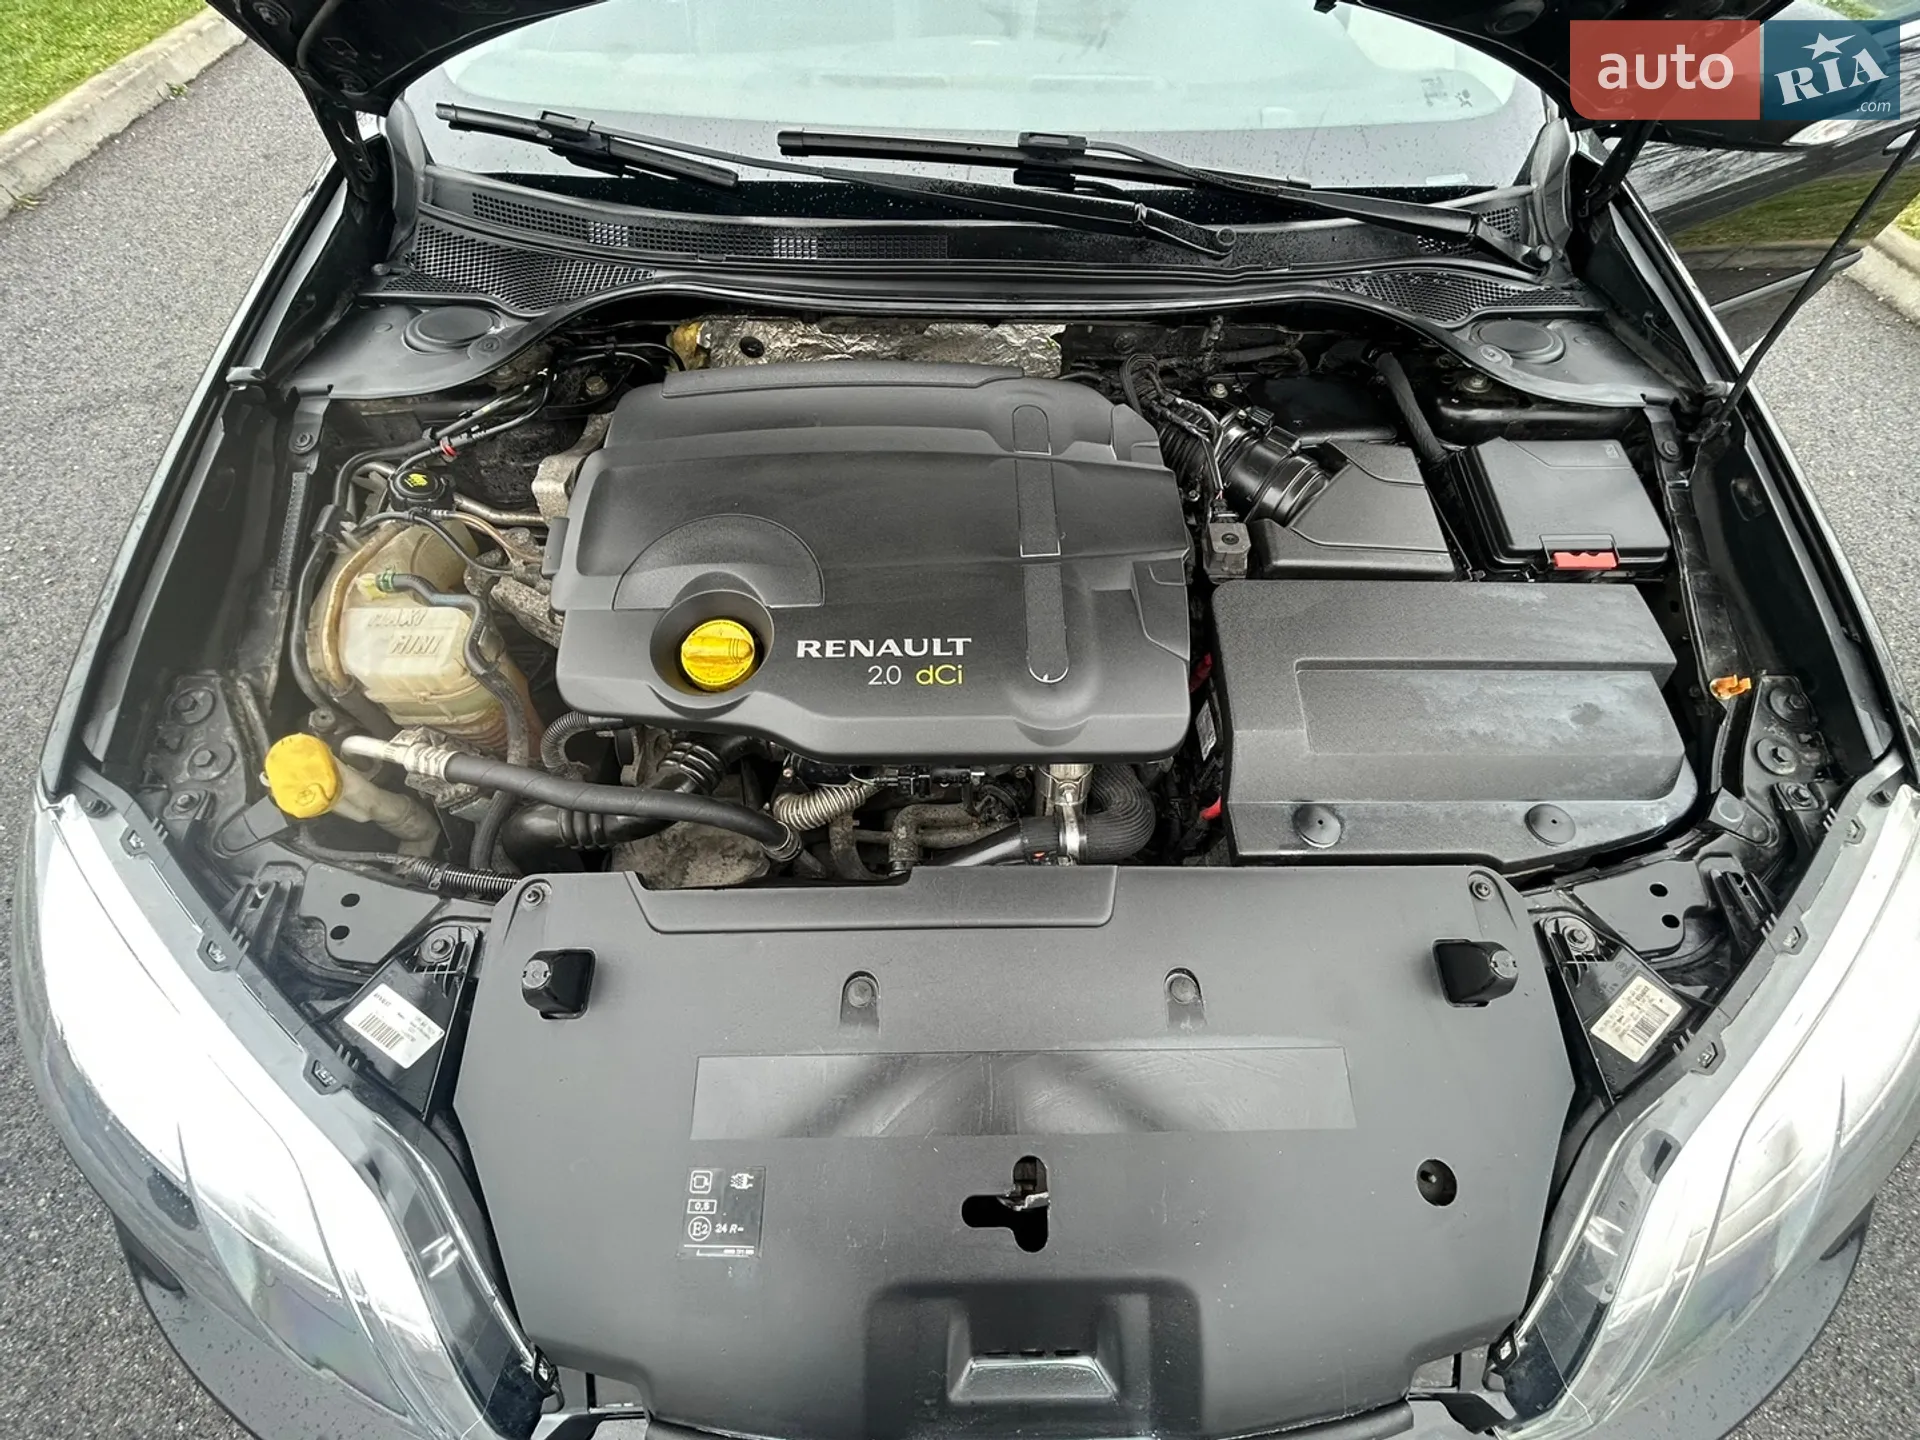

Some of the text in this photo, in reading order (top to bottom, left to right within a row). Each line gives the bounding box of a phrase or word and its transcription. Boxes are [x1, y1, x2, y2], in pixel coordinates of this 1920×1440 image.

[796, 637, 972, 658] RENAULT
[867, 663, 964, 686] 2.0 dCi
[692, 1221, 709, 1237] E2
